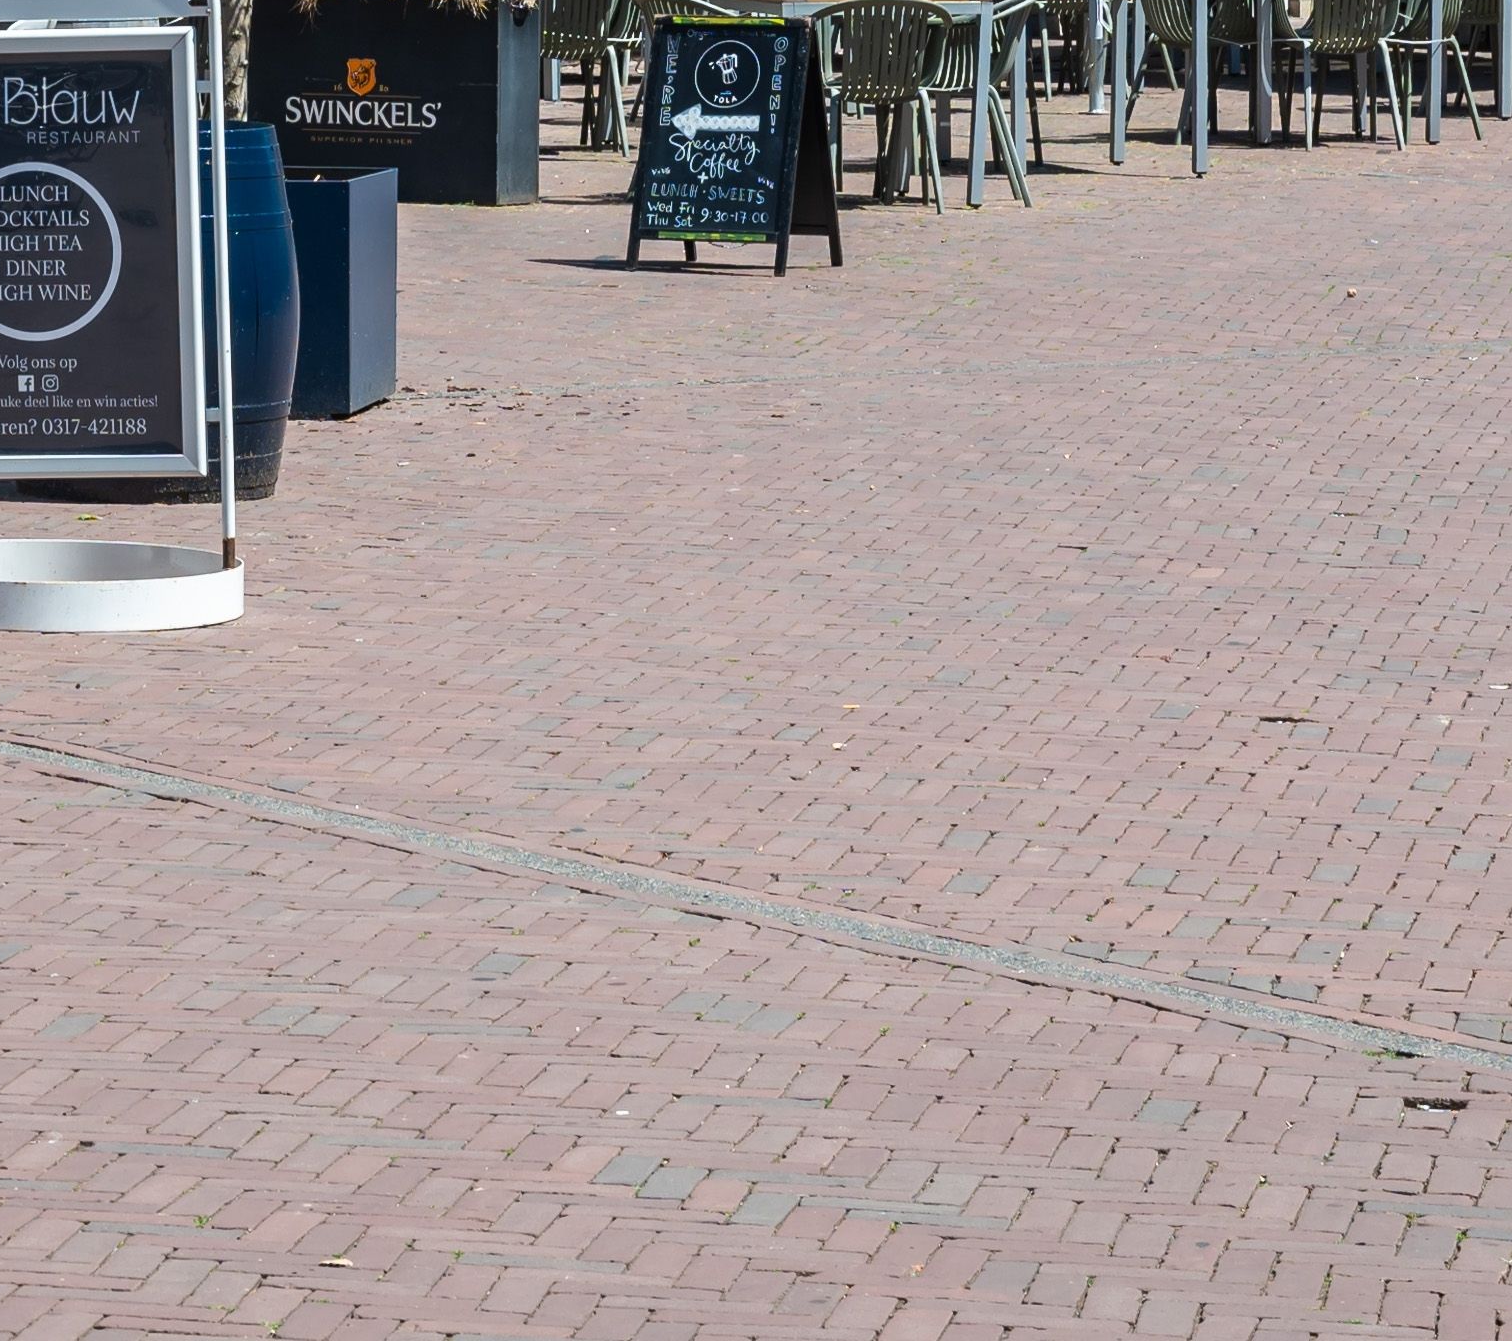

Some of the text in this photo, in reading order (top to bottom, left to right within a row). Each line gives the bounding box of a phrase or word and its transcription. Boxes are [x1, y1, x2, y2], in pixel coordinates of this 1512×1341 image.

[769, 36, 789, 134] OPEN!
[3, 77, 140, 125] Blauw
[713, 94, 738, 105] TOLA
[285, 96, 442, 128] SWINCKELS'
[27, 129, 141, 145] RESTAURANT
[310, 135, 413, 146] SUPERIOR PILSNER
[668, 132, 761, 165] Specialty
[689, 152, 742, 179] Coffee
[0, 185, 69, 202] LUNCH
[650, 182, 766, 205] LUNCH SWEETS
[647, 201, 695, 215] Wed Fri
[646, 214, 694, 228] Thu Sat
[44, 234, 83, 252] TEA
[6, 260, 67, 277] DINER
[38, 284, 91, 301] WINE
[31, 357, 56, 368] ons
[59, 357, 77, 372] op
[24, 395, 49, 408] deel
[52, 395, 74, 408] like
[76, 398, 92, 408] en
[94, 395, 117, 408] win
[120, 395, 158, 408] acties!
[42, 418, 147, 435] 0317-421188
